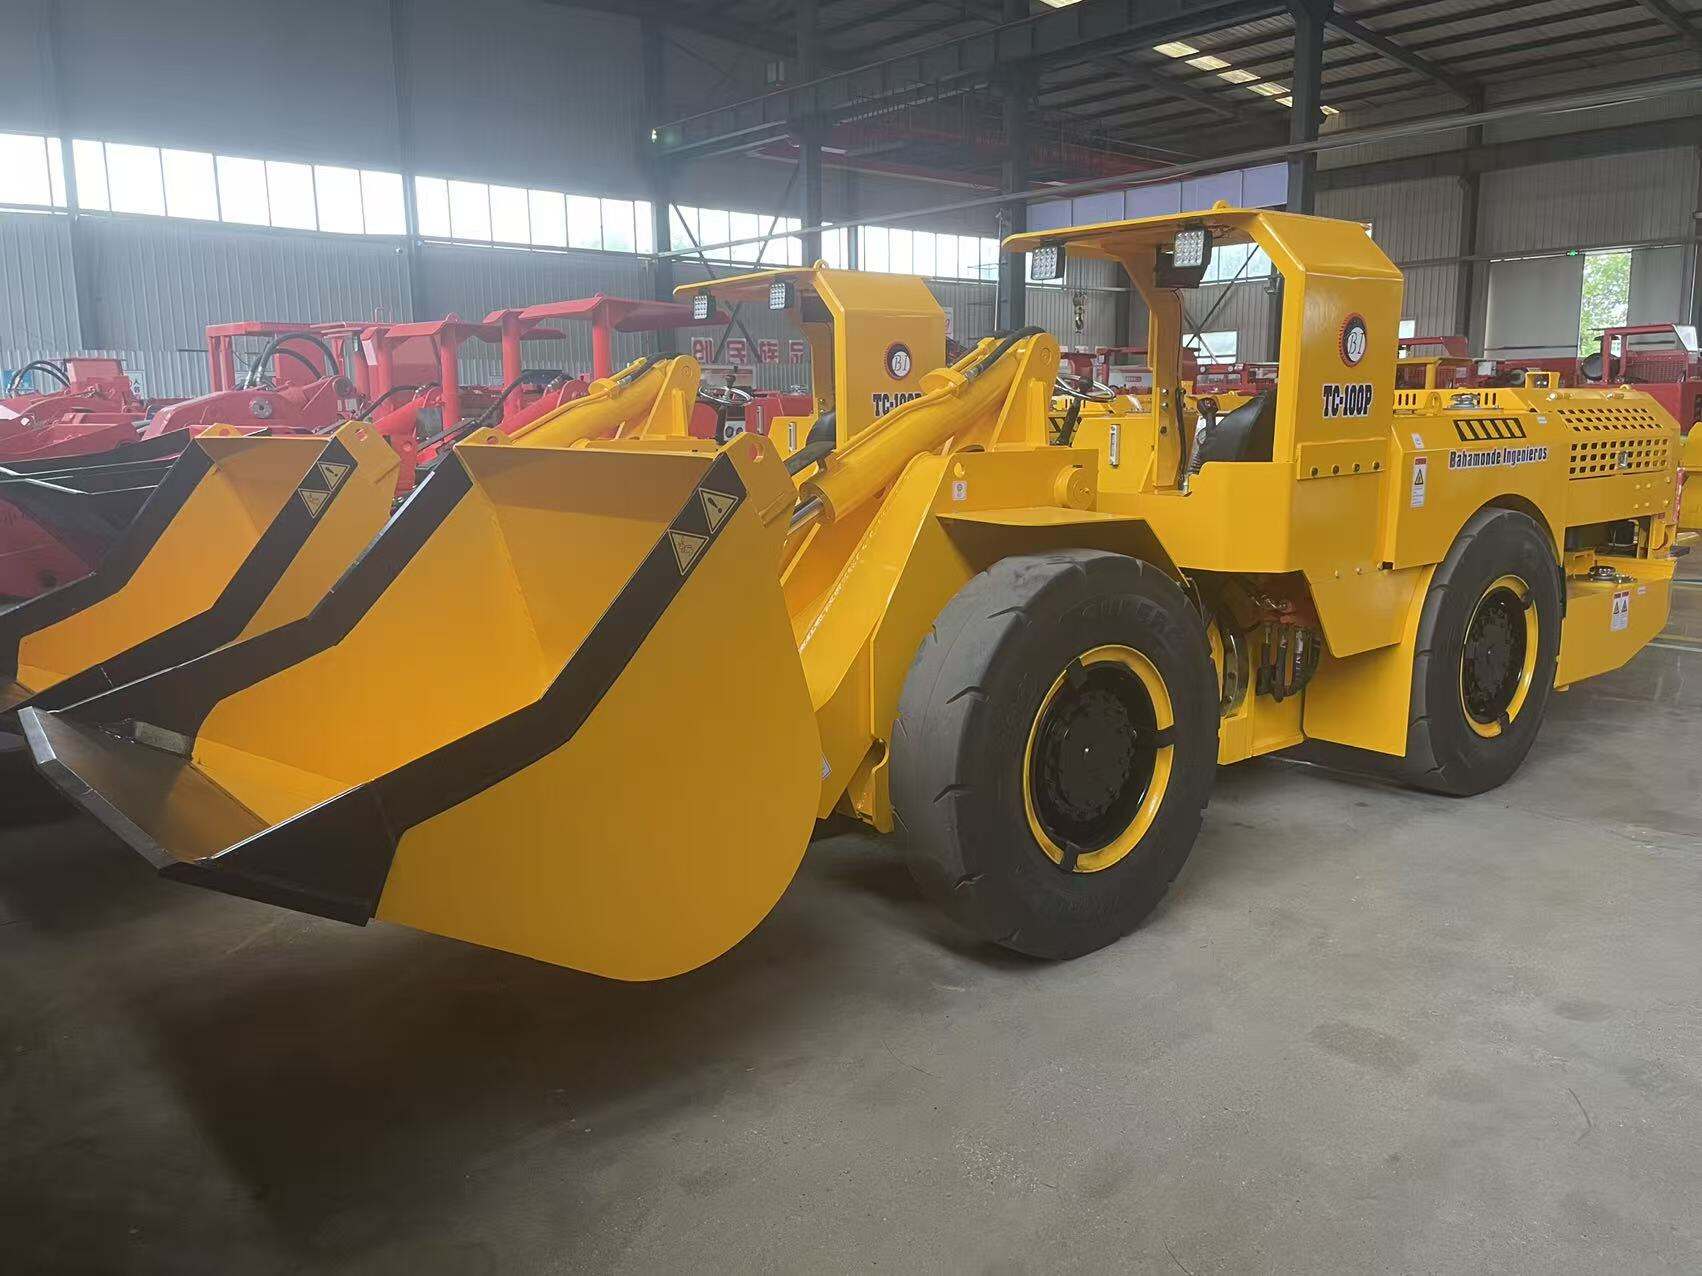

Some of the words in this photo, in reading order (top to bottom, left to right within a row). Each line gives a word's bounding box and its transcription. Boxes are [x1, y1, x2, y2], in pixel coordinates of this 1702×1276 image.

[1323, 384, 1373, 417] TC-100P
[1449, 448, 1501, 468] Bahamonde
[1503, 446, 1548, 465] Ingenieros
